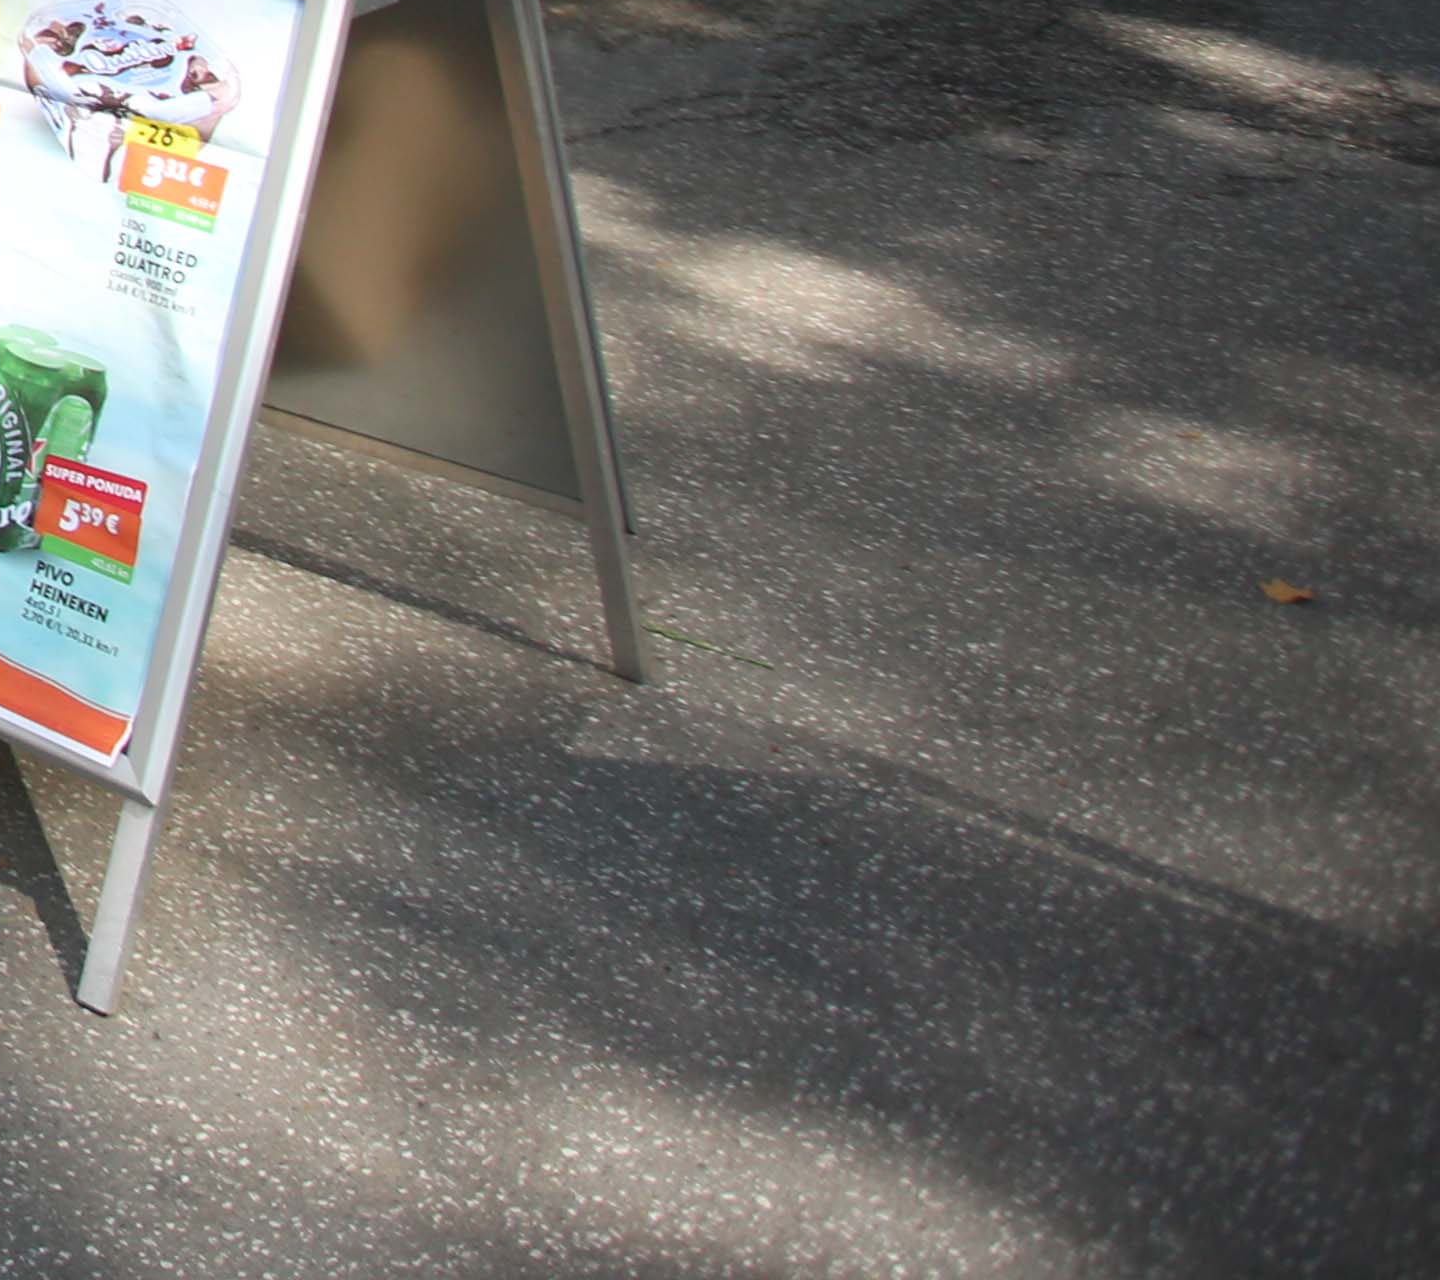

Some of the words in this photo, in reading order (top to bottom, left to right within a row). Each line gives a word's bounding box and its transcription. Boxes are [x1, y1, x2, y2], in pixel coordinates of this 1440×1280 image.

[114, 251, 186, 284] QUATTRO
[118, 233, 199, 268] SLADOLED
[45, 464, 85, 487] SUPER
[86, 475, 143, 503] PONUDA
[36, 560, 75, 587] PIVO
[31, 579, 110, 624] HEINEKEN
